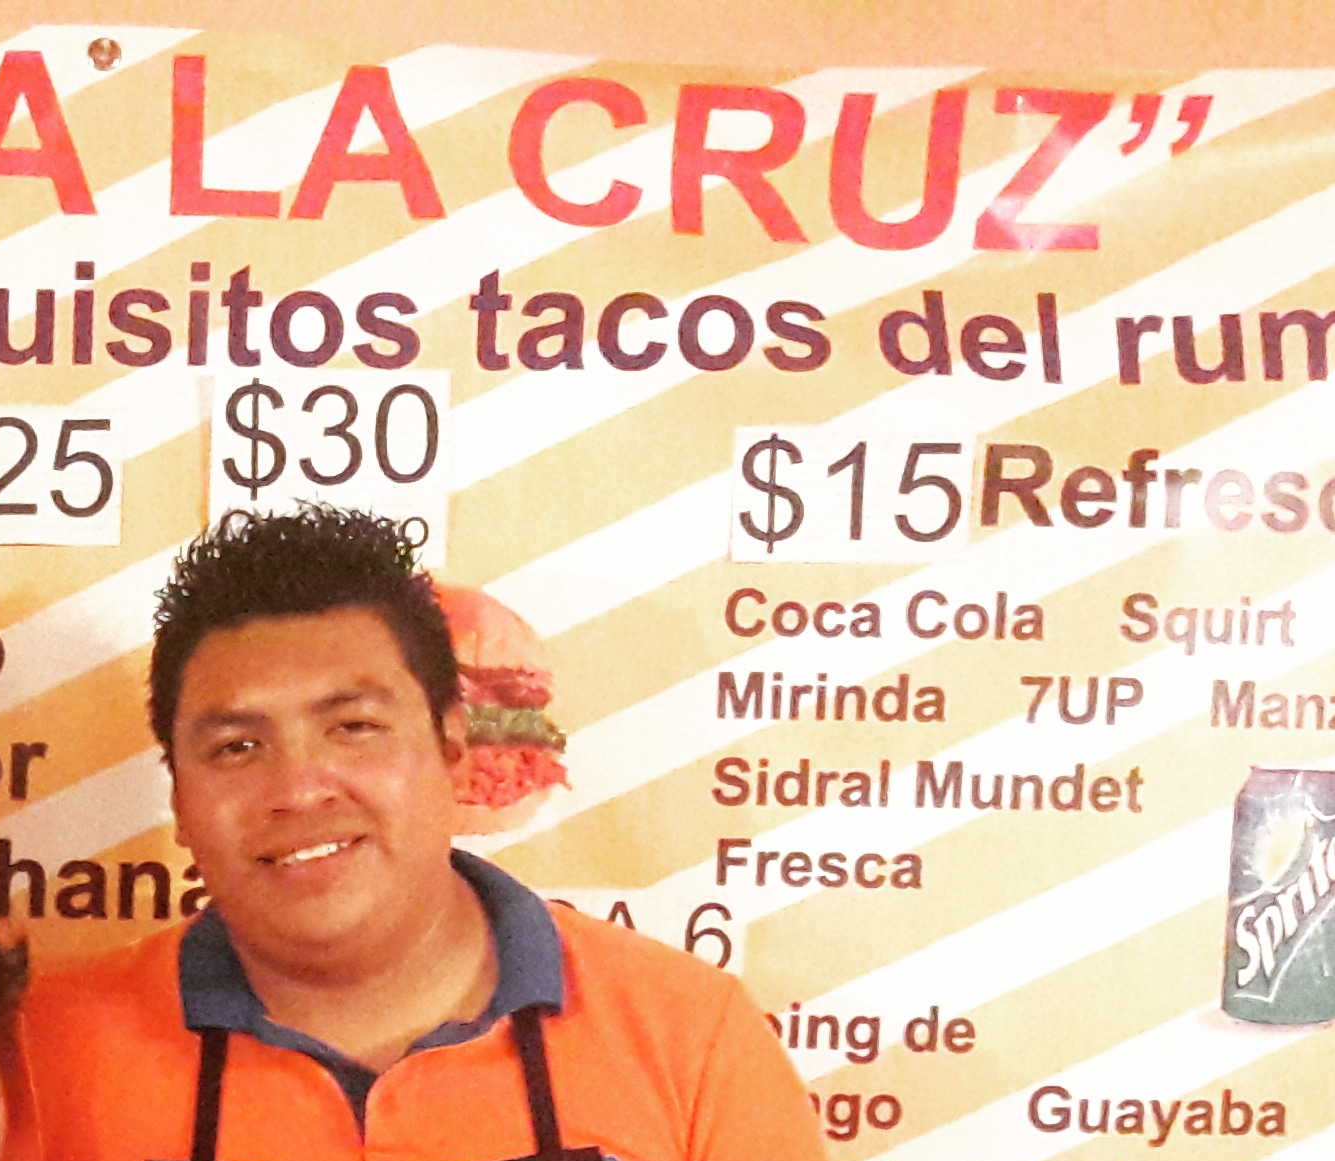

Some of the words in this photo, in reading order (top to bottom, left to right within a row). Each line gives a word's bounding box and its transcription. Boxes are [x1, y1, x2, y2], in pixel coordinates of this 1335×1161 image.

[169, 54, 447, 220] LA
[469, 268, 831, 372] tacos
[878, 290, 1063, 385] del
[222, 377, 439, 500] $30
[738, 433, 962, 554] $15
[724, 587, 882, 639] Coca
[906, 589, 1044, 641] Cola
[1119, 592, 1296, 656] Squirt
[716, 672, 946, 722] Mirinda
[1020, 676, 1144, 726] 7UP
[1210, 680, 1335, 731] Man
[711, 757, 891, 808] Sidral
[914, 761, 1144, 813] Mundet
[715, 838, 923, 890] Fresca
[904, 1005, 976, 1054] de
[809, 1092, 903, 1142] go
[1027, 1085, 1287, 1148] Guayaba
